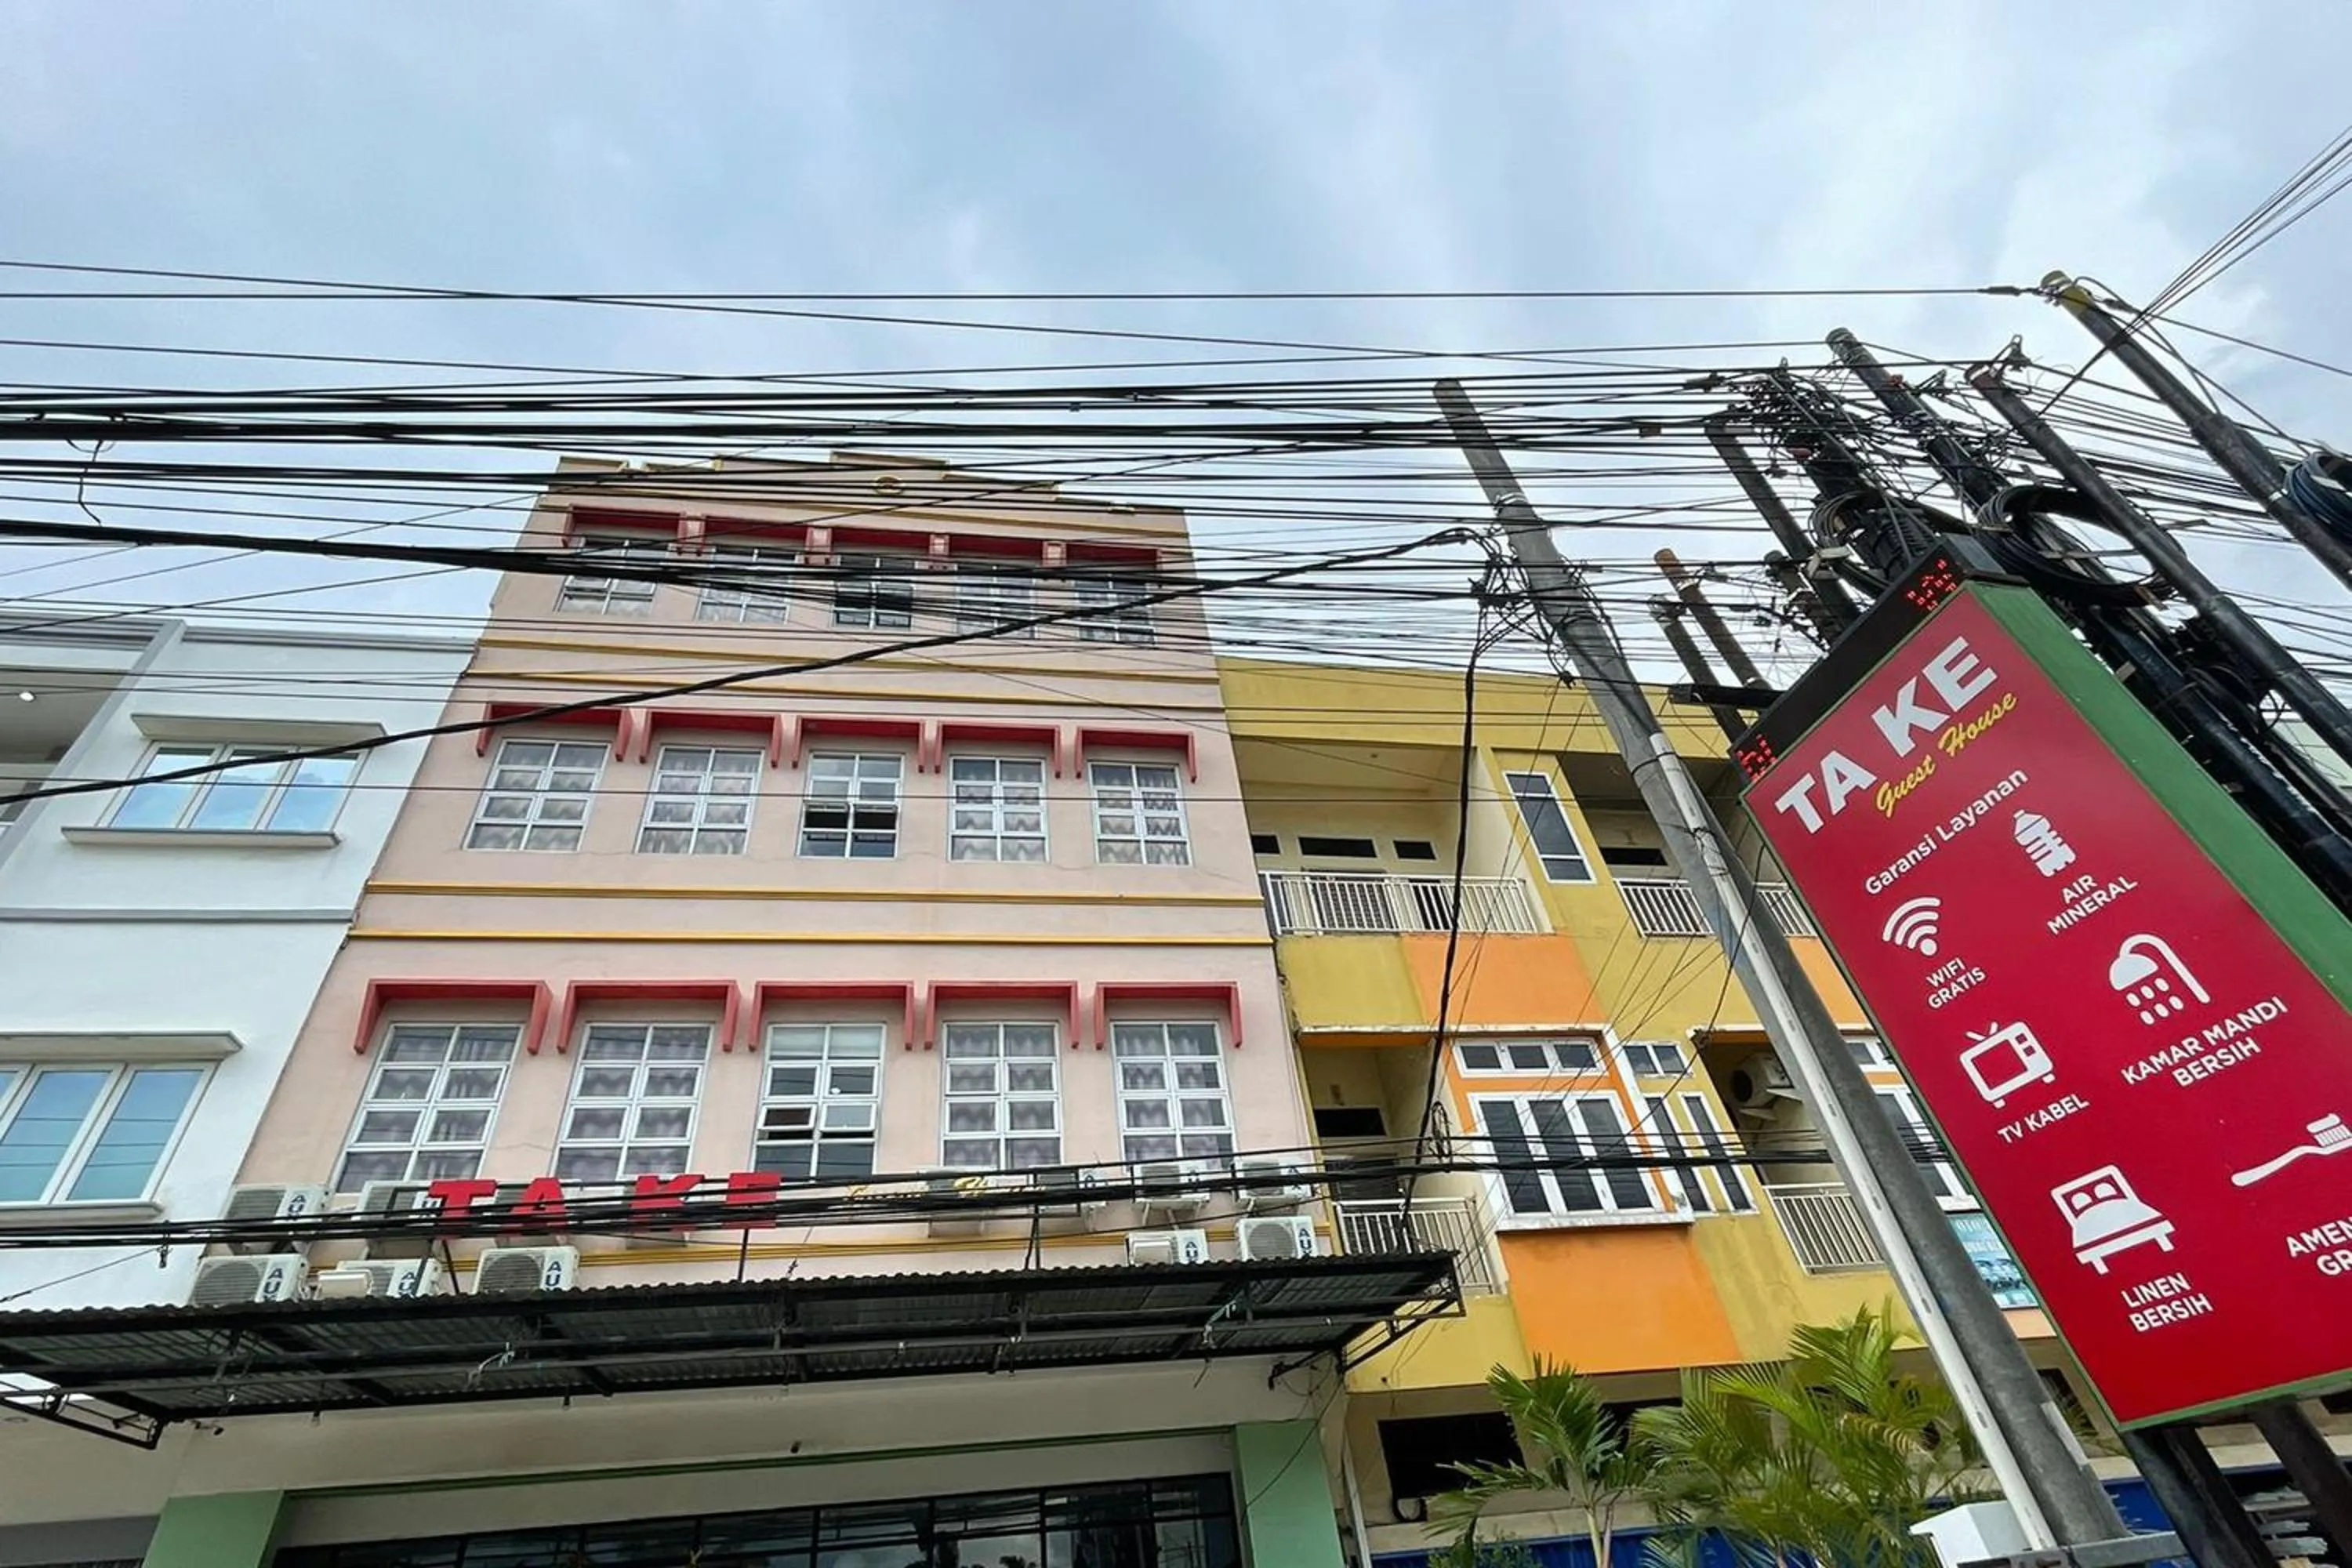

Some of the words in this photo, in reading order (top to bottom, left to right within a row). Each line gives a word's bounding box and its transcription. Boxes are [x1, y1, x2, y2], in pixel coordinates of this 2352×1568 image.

[1774, 750, 1878, 834] TA
[1871, 636, 1998, 758] KE
[1874, 754, 1936, 819] Guest
[1936, 691, 2018, 757] House
[1865, 833, 1937, 895] Garansi
[1935, 770, 2029, 842] Layanan
[2047, 877, 2139, 935] MINERAL
[2062, 874, 2098, 905] AIR
[1926, 957, 1966, 988] WIFI
[1928, 967, 1987, 1009] GRATIS
[2121, 1036, 2205, 1084] KAMAR
[2201, 996, 2288, 1047] MANDI
[2172, 1036, 2261, 1087] BERSIH
[1998, 1119, 2024, 1144] TV
[2024, 1094, 2089, 1131] KABEL
[2121, 1272, 2191, 1308] LINEN
[2129, 1293, 2214, 1333] BERSIH
